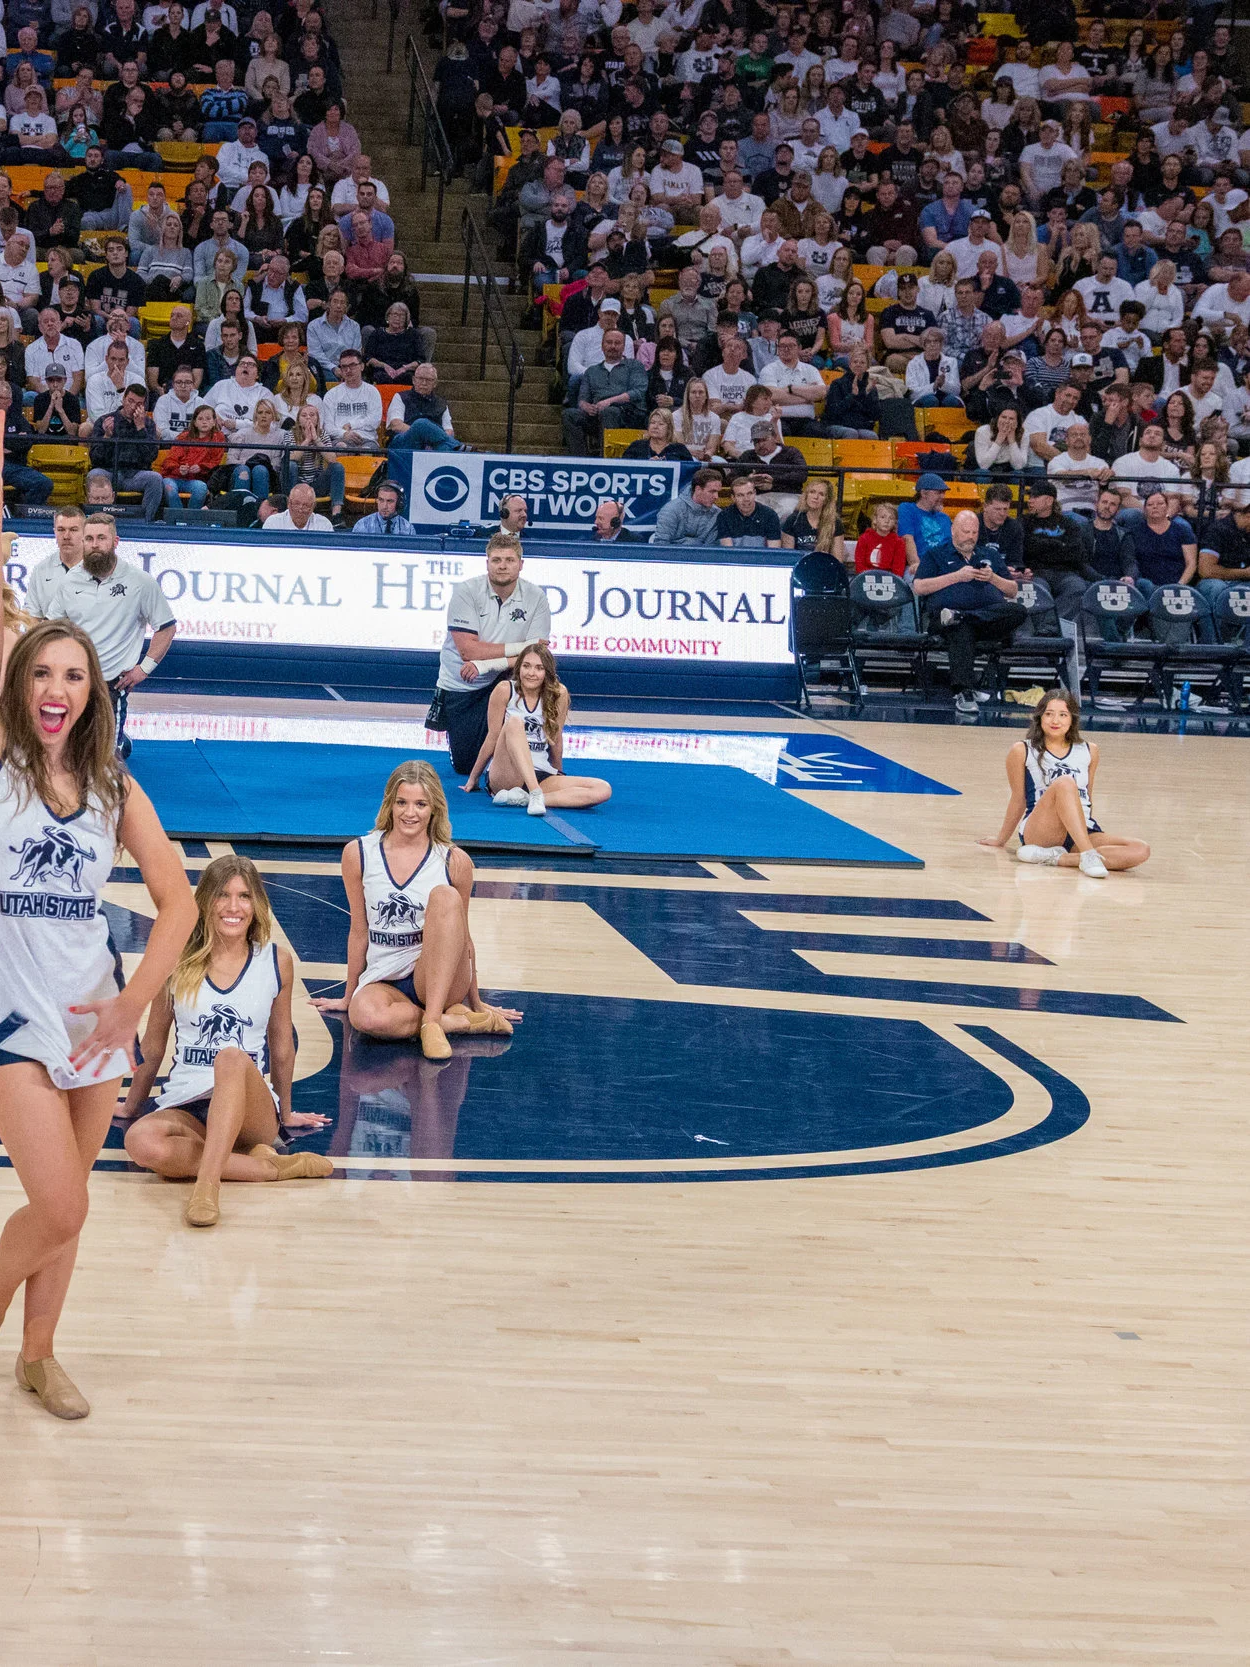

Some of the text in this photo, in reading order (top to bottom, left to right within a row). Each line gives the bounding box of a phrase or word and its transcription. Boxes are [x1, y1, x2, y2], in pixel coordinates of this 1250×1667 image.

[1088, 291, 1115, 313] A
[169, 419, 191, 430] STAT
[489, 468, 667, 496] CBS SPORTS
[488, 492, 637, 519] NTWOK
[426, 560, 464, 576] THE
[372, 562, 786, 628] HED JOURNAL
[150, 620, 277, 639] OMMUNITY
[563, 635, 600, 651] THE
[604, 637, 722, 656] COMMUNITY
[45, 892, 96, 921] STATE
[370, 930, 424, 948] UTAH STAT
